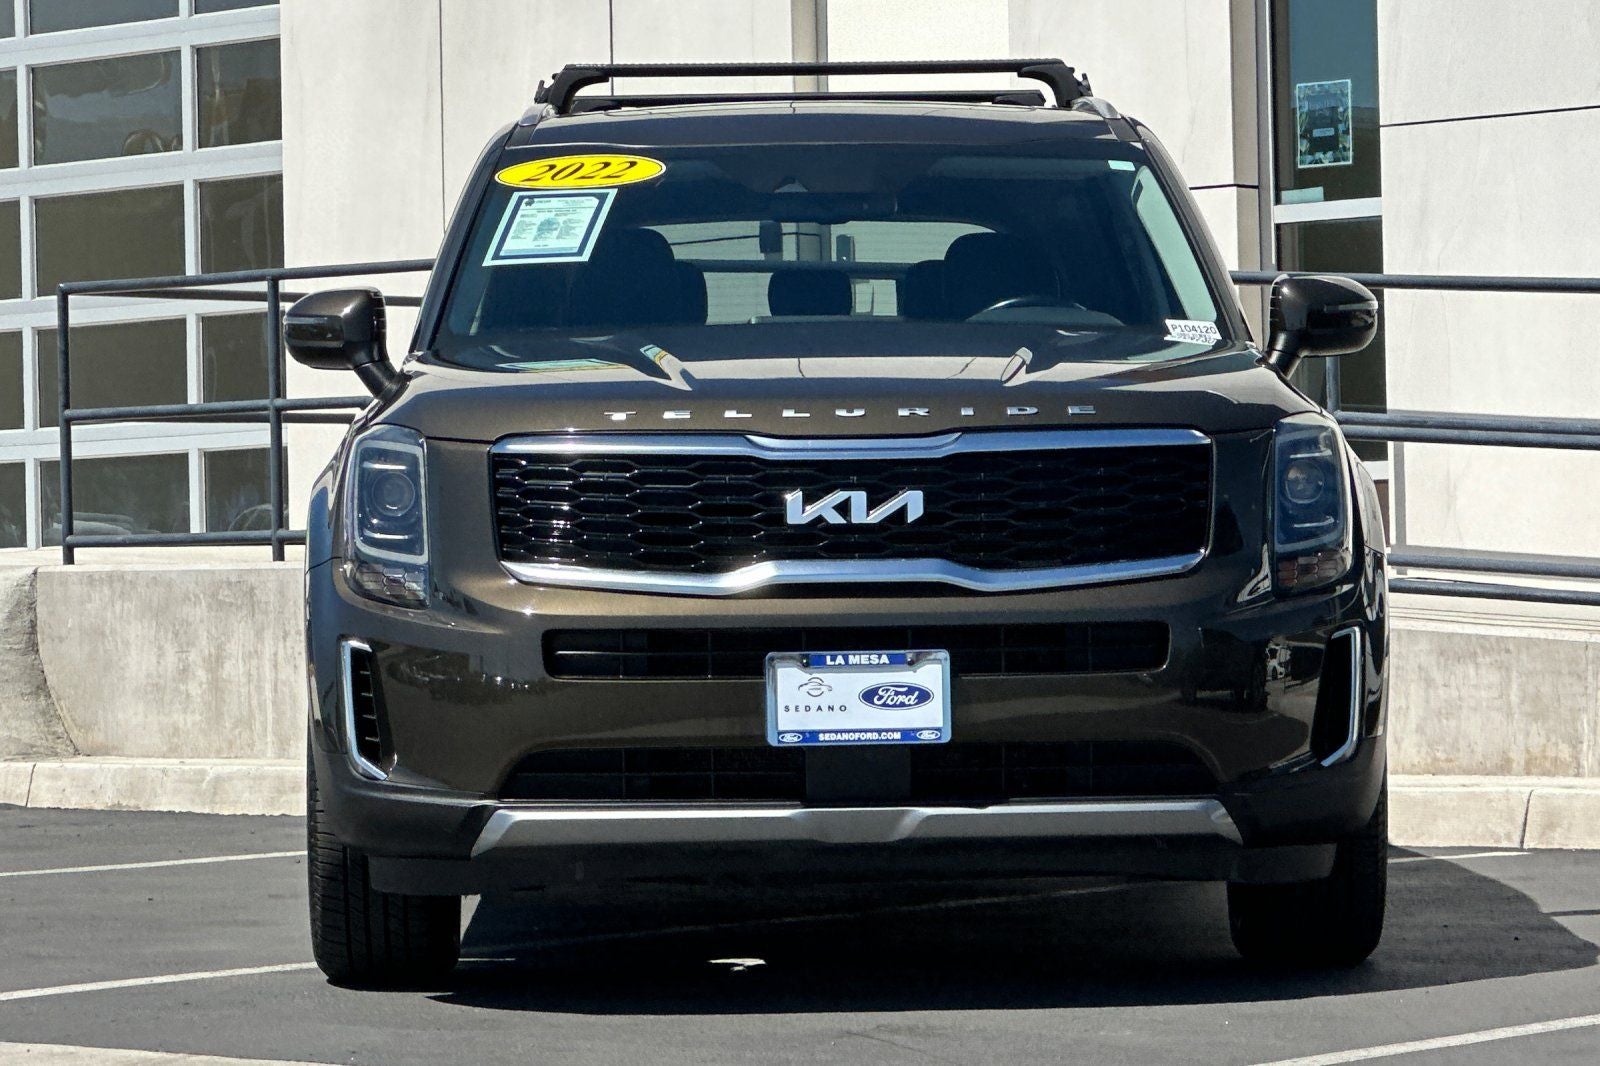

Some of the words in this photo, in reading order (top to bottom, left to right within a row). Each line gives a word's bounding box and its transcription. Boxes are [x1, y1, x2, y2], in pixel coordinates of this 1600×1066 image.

[521, 160, 638, 182] 2022
[1171, 324, 1217, 334] P104120
[603, 405, 1097, 420] TELLURIDE
[785, 489, 924, 525] KIA
[826, 655, 845, 666] LA
[848, 653, 890, 665] MESA
[873, 685, 919, 706] Ford
[784, 704, 847, 712] SEDANO
[818, 732, 901, 741] SEDANOFORD.COM
